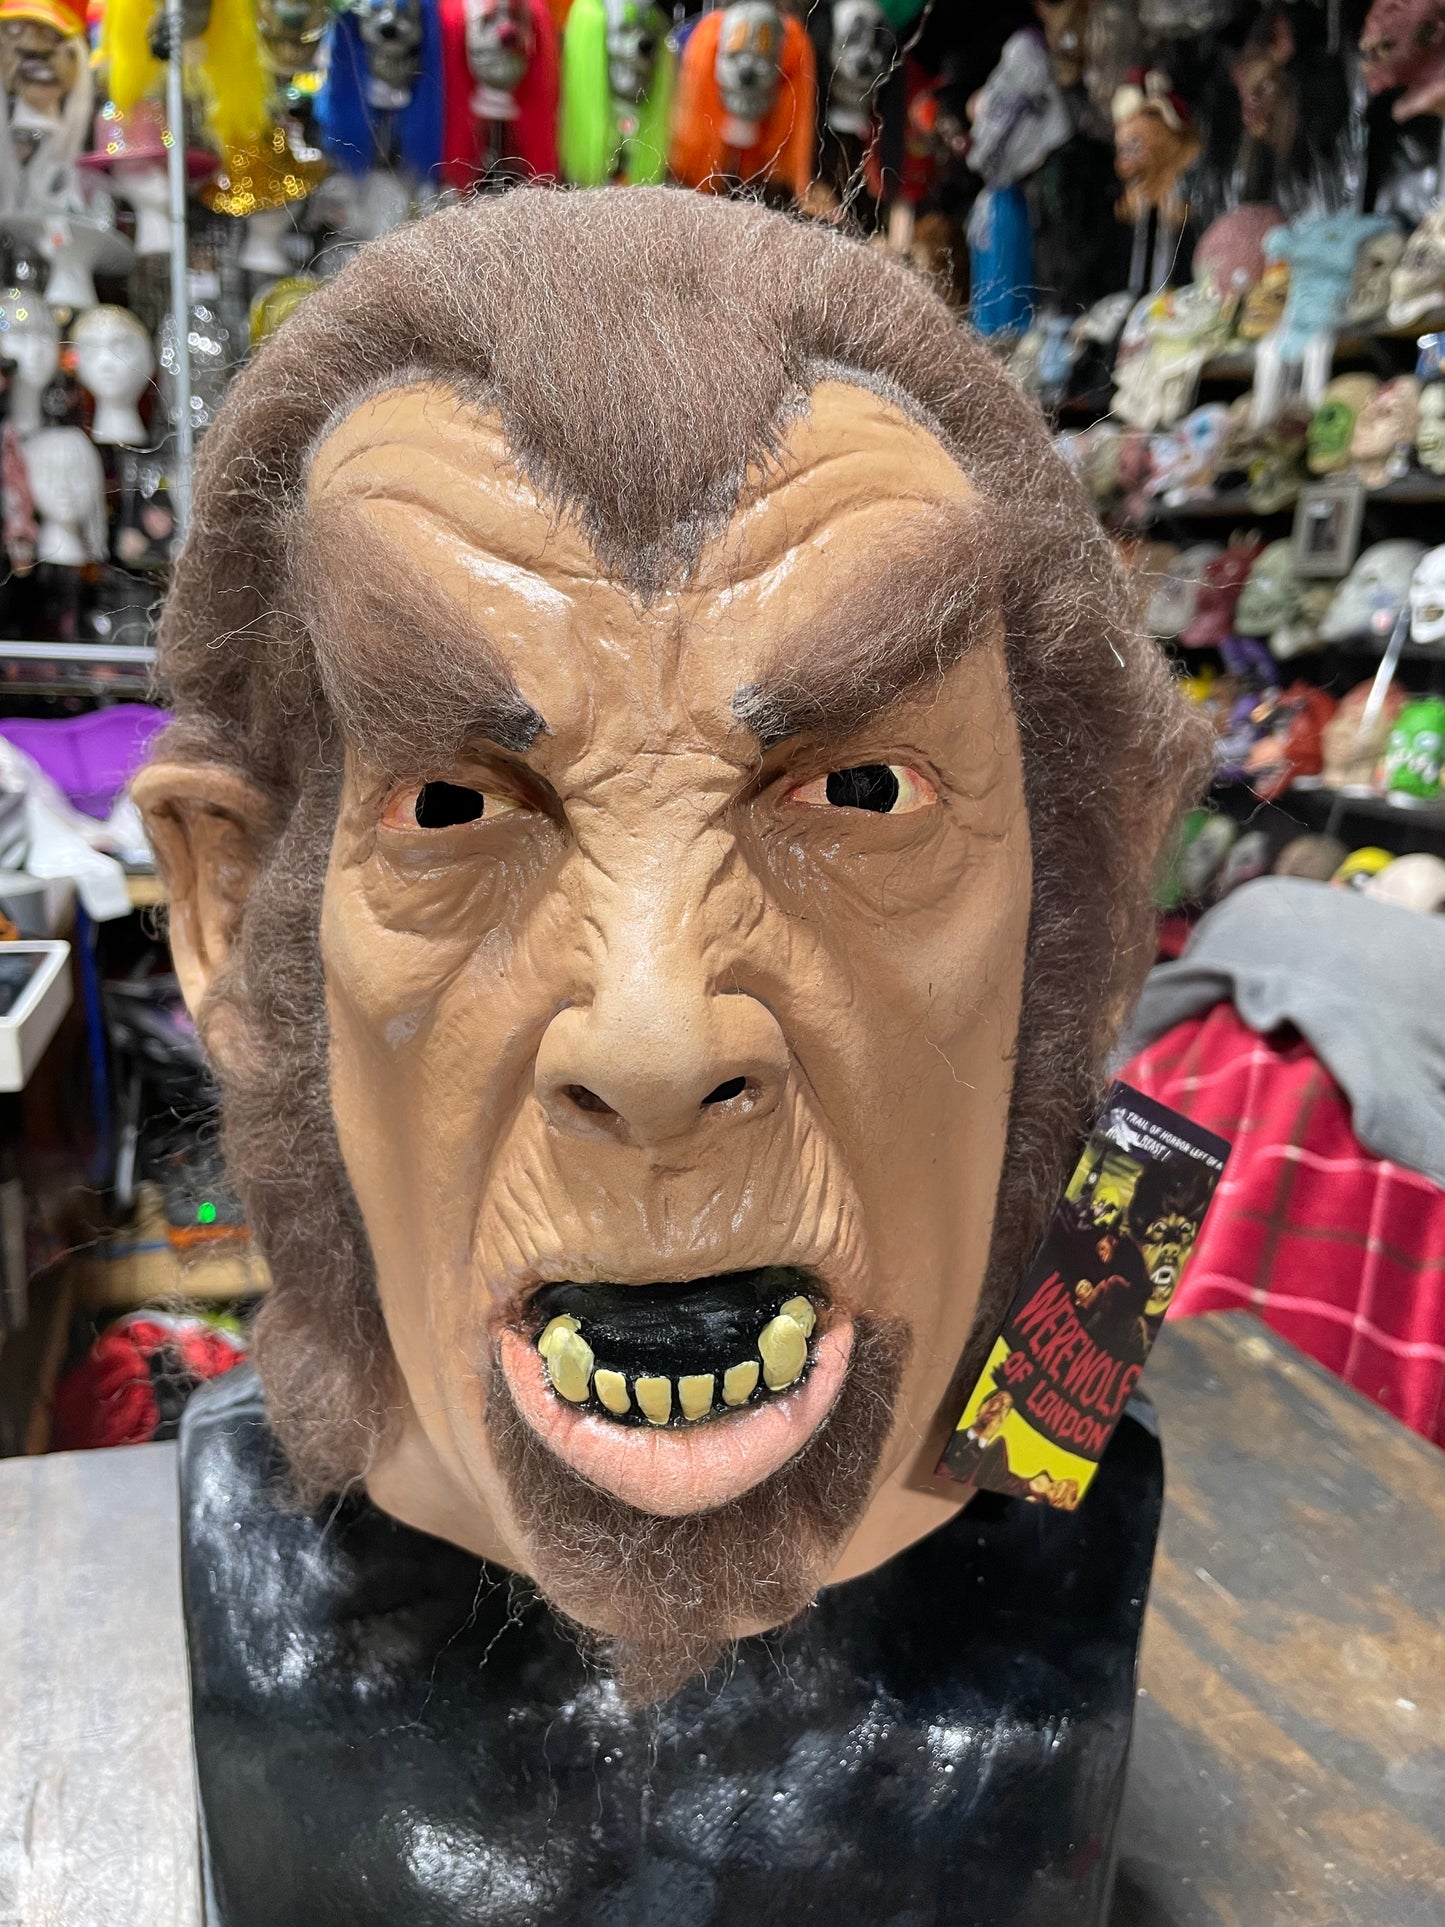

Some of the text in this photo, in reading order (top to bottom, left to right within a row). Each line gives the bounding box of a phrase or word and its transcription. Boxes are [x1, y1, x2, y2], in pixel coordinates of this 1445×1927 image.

[1126, 1111, 1149, 1131] TRAIL
[1149, 1124, 1163, 1135] OF
[1159, 1130, 1191, 1153] HORROR
[1189, 1147, 1207, 1160] LEFT
[1012, 1270, 1143, 1417] WEREWOLF
[1003, 1351, 1112, 1451] OF LONDON
